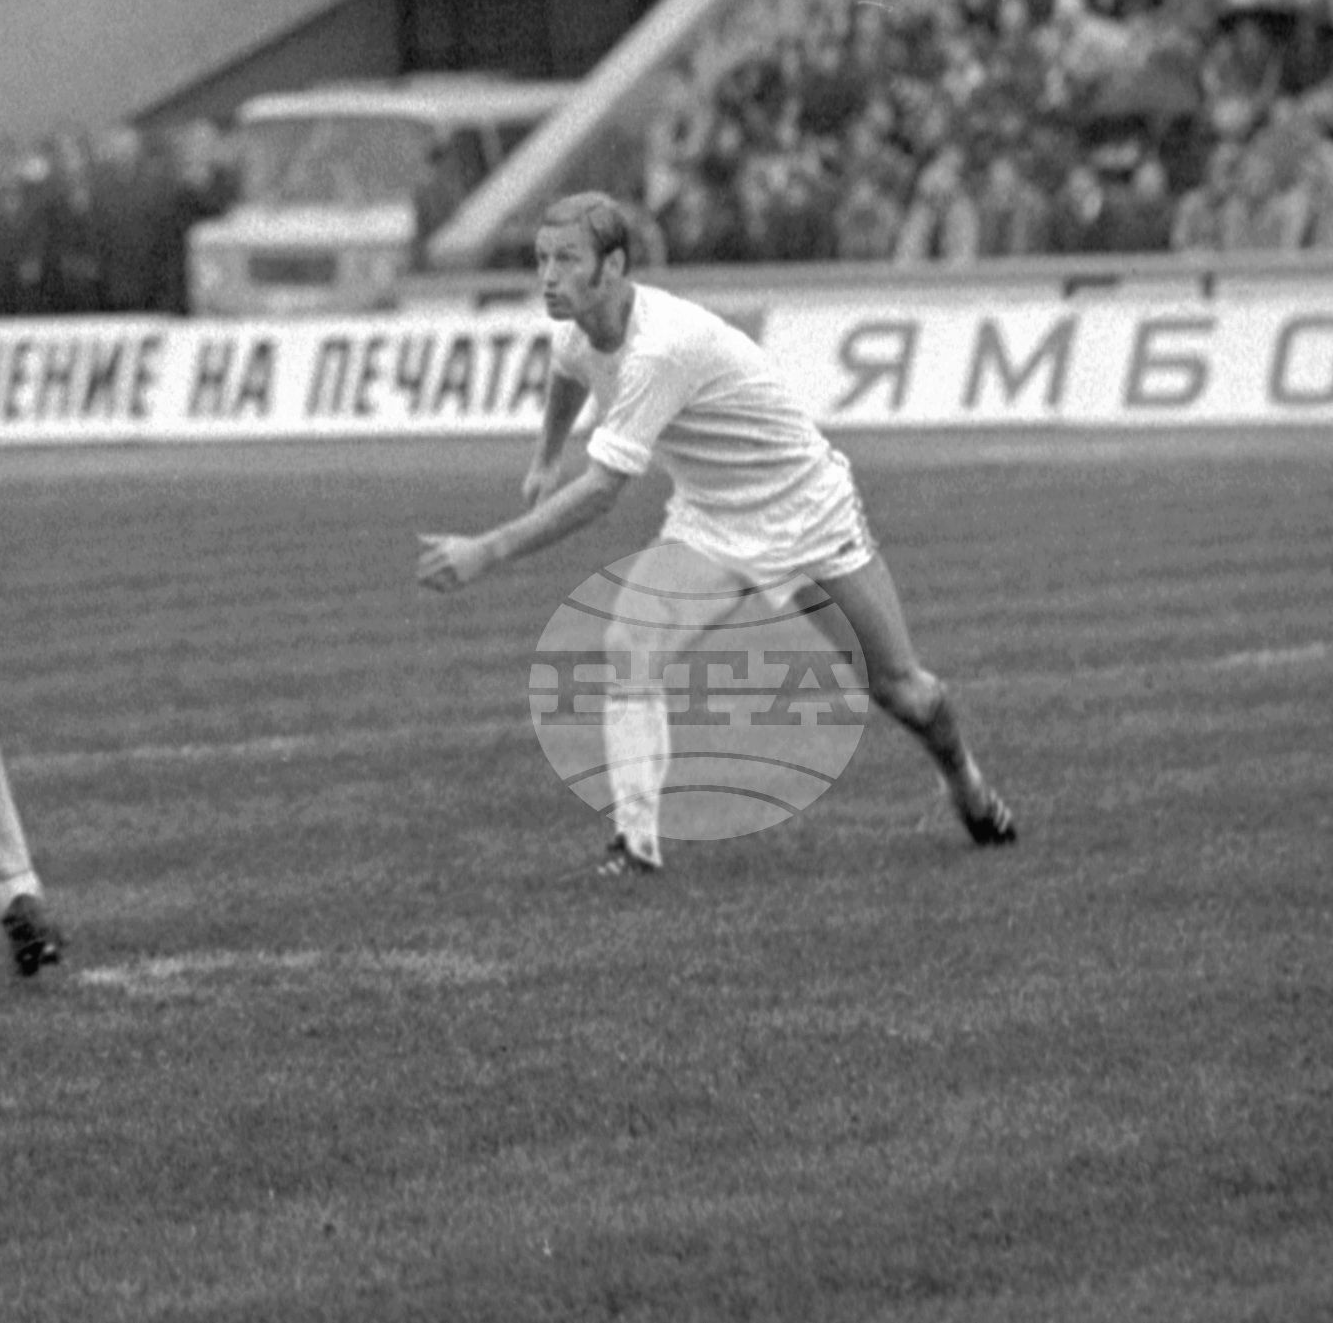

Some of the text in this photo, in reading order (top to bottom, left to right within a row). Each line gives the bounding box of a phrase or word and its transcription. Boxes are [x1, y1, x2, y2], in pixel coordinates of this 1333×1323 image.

[186, 336, 276, 417] НА
[305, 332, 554, 417] ПЕЧАТА
[835, 315, 1333, 410] ЯМБО
